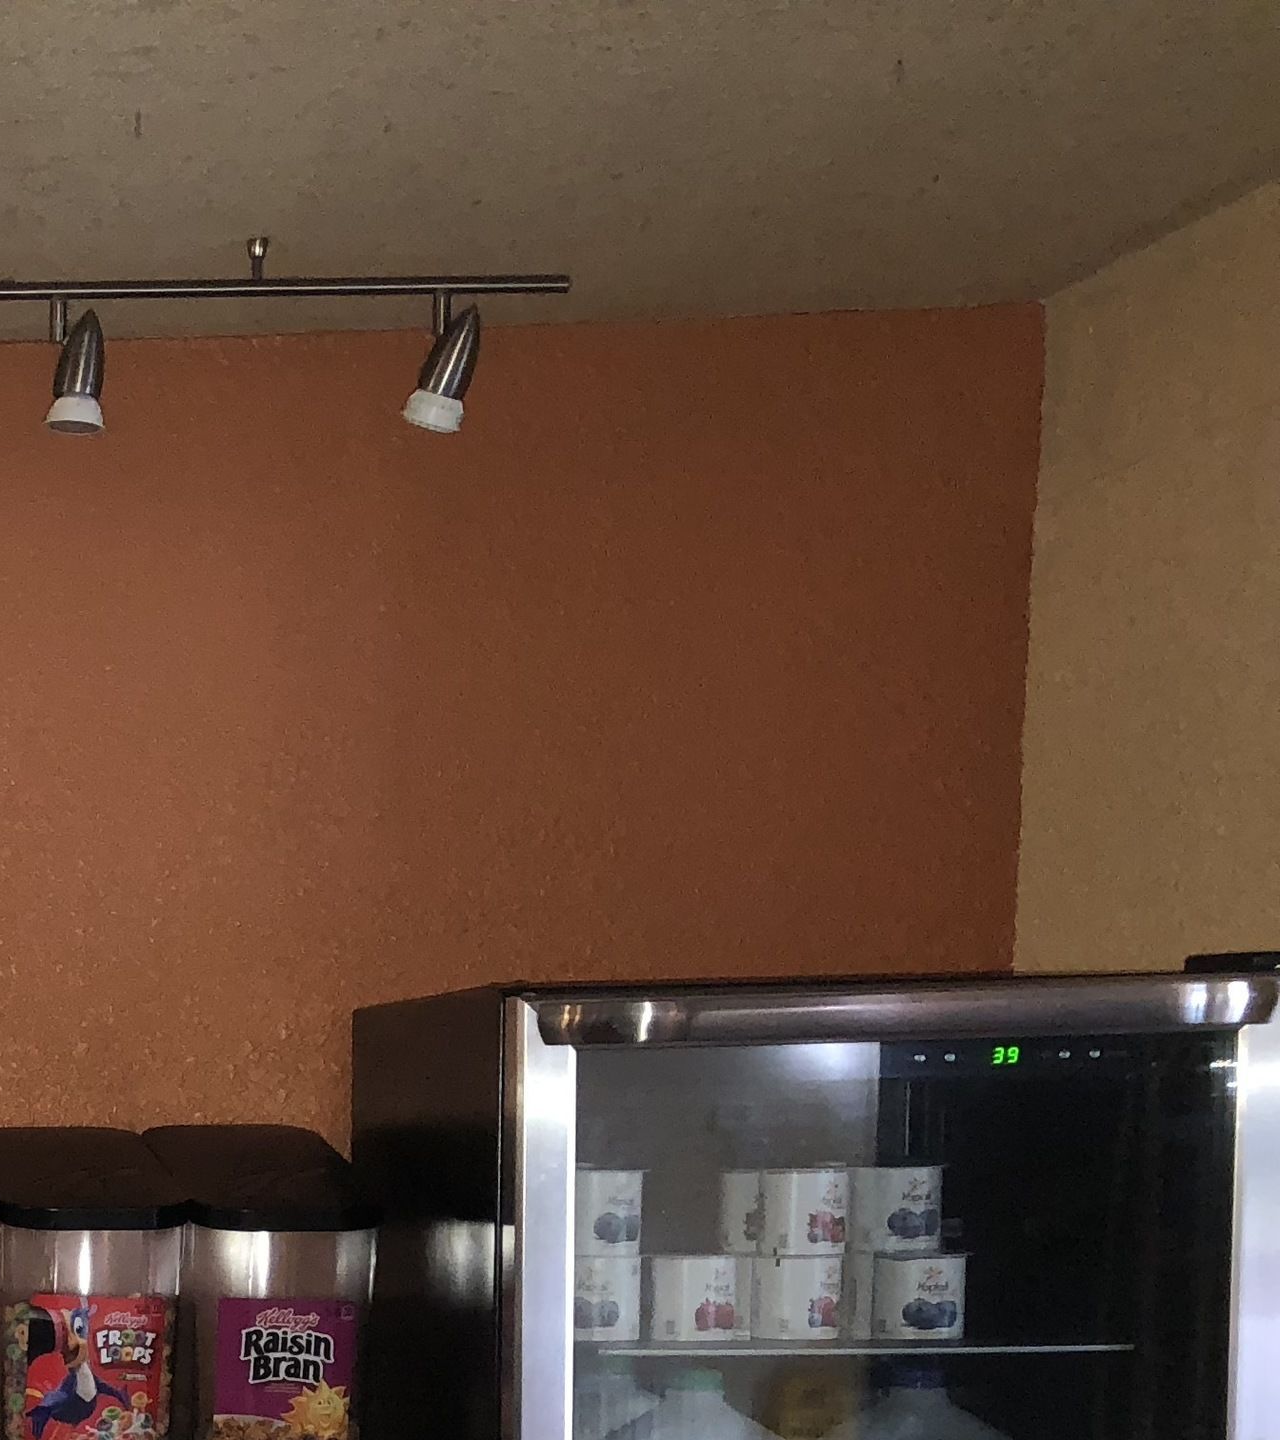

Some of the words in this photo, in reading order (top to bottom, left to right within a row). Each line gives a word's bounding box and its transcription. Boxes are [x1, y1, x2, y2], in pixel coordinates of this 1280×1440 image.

[992, 1046, 1020, 1065] 39
[96, 1328, 157, 1348] FROOT
[241, 1328, 333, 1362] Raisin
[100, 1346, 154, 1364] LOOPS
[250, 1355, 322, 1384] Bran
